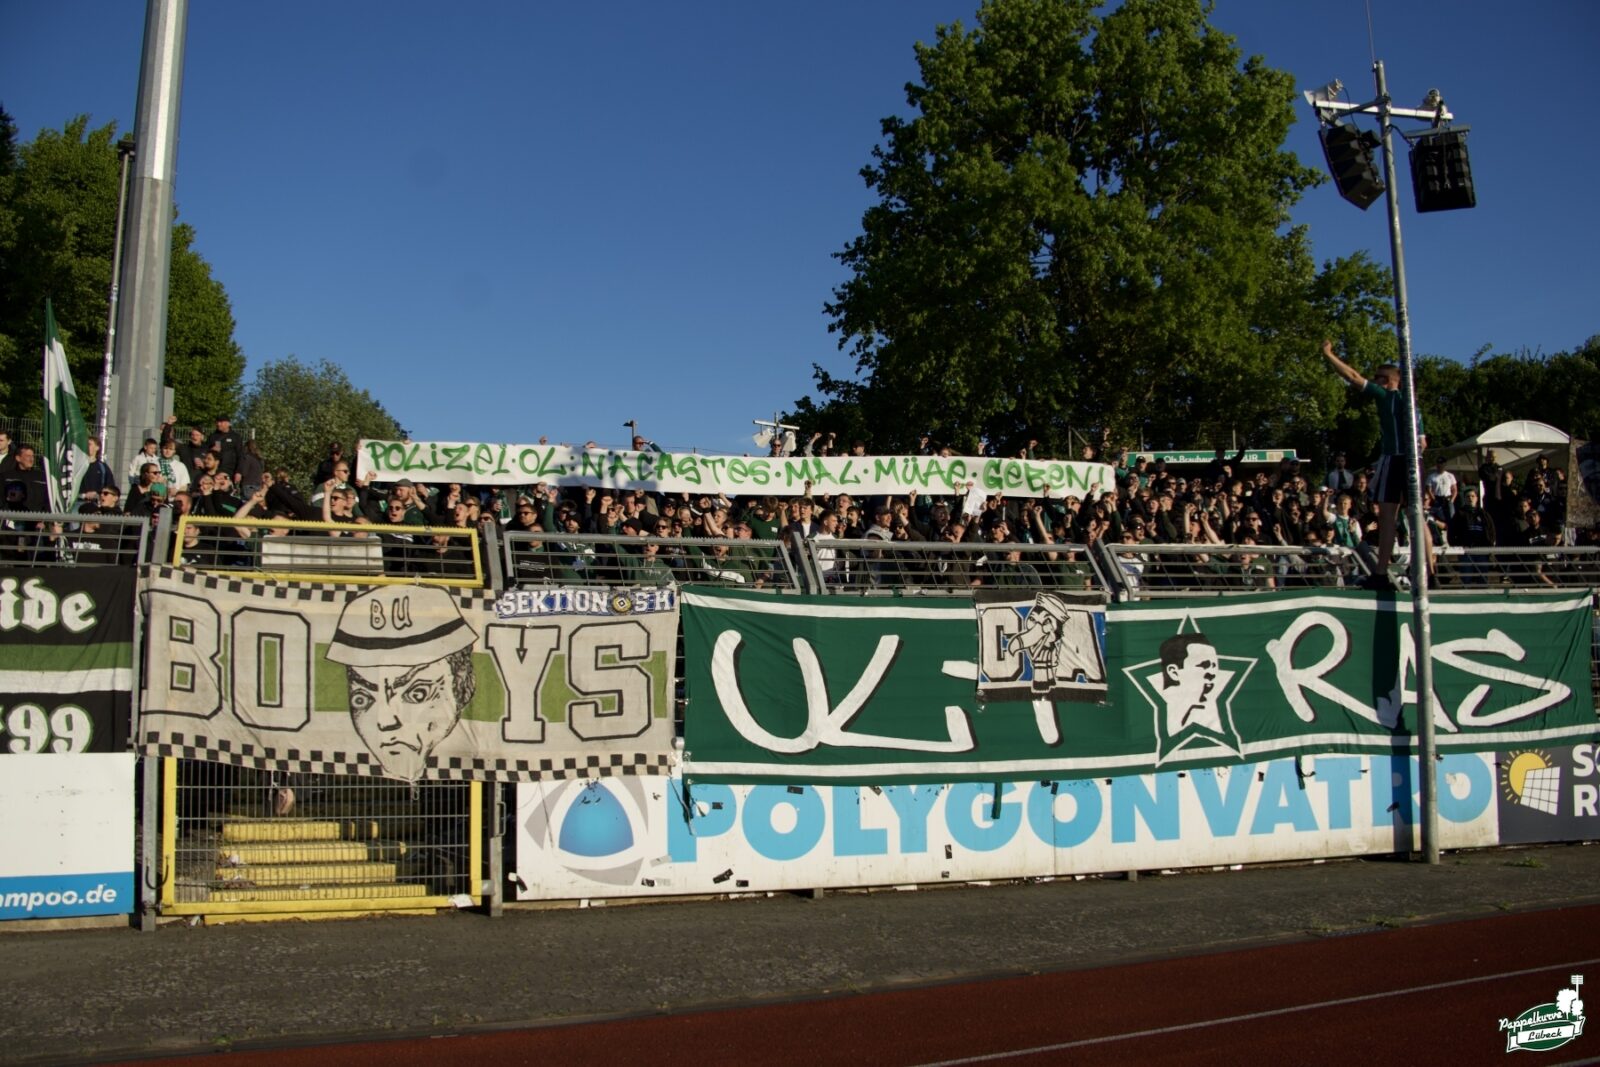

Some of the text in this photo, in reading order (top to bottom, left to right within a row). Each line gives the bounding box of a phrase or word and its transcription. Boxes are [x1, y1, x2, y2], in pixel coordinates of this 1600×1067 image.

[370, 595, 413, 631] BU
[502, 590, 609, 615] SEKTION
[139, 588, 653, 745] BOYS
[0, 704, 92, 753] 99
[1572, 743, 1600, 777] S
[666, 752, 1493, 863] POLYGONVATRO
[1573, 784, 1600, 817] R
[0, 883, 117, 911] mpoo.de
